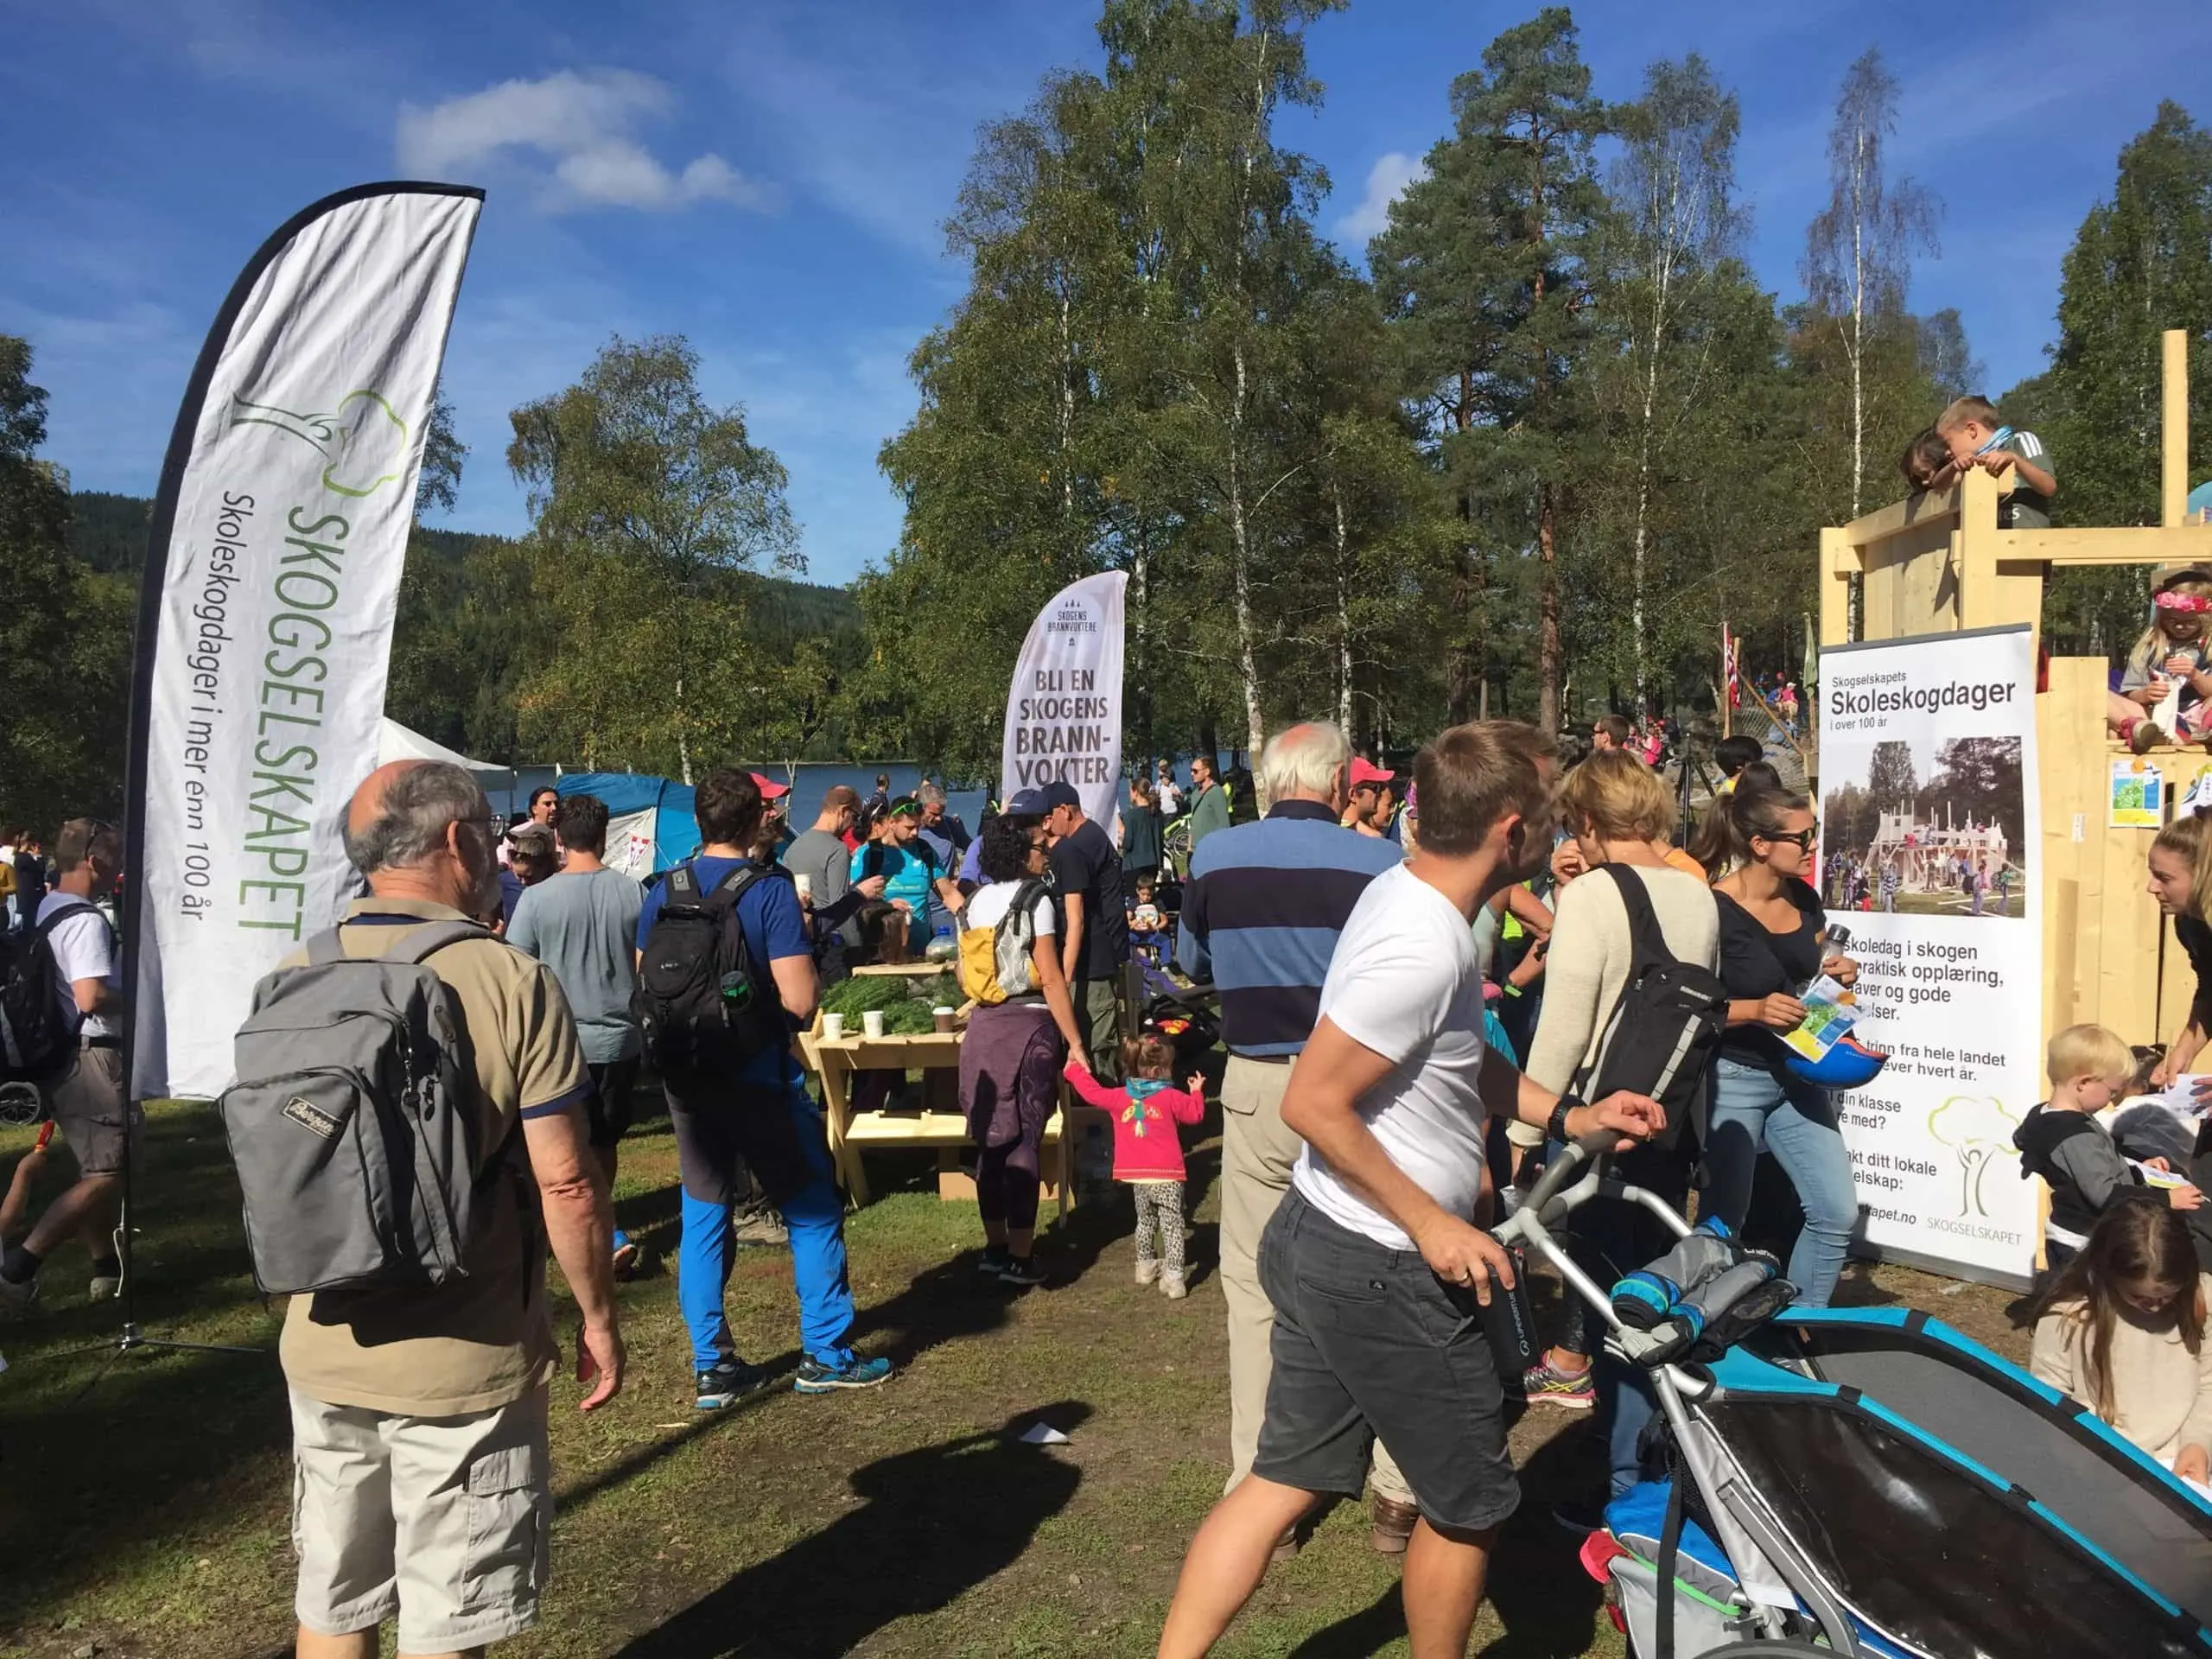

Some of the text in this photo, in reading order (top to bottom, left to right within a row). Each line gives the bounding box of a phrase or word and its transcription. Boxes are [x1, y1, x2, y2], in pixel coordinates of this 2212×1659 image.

[187, 491, 255, 700] Skoleskogdager
[1058, 610, 1087, 621] SKOGENS
[1036, 669, 1095, 692] BLI EN
[1832, 671, 1907, 689] Skogselskapets
[1020, 697, 1109, 721] SKOGENS
[1831, 680, 2017, 715] Skoleskogdager
[238, 505, 350, 942] SKOGSELSKAPET
[1834, 720, 1856, 731] over
[1859, 716, 1875, 728] 100
[1877, 714, 1888, 728] år
[184, 720, 213, 774] mer
[1015, 725, 1111, 754] BRANN-
[1014, 757, 1109, 787] VOKTER
[185, 780, 205, 830] enn
[184, 842, 211, 887] 100
[181, 894, 212, 921] år
[1907, 940, 1911, 956] i
[1916, 942, 1978, 963] skogen
[1911, 964, 2005, 988] opplæring,
[1851, 982, 1951, 1004] aver og gode
[1900, 1043, 1919, 1058] fra
[1924, 1045, 1955, 1061] hele
[1960, 1048, 2005, 1067] landet
[1917, 1061, 1955, 1079] hvert
[1960, 1064, 1977, 1081] år.
[1859, 1093, 1901, 1113] klasse
[1851, 1114, 1886, 1129] med?
[1867, 1153, 1891, 1168] ditt
[1895, 1156, 1937, 1176] lokale
[1927, 1217, 2022, 1245] SKOGSELSKAPET
